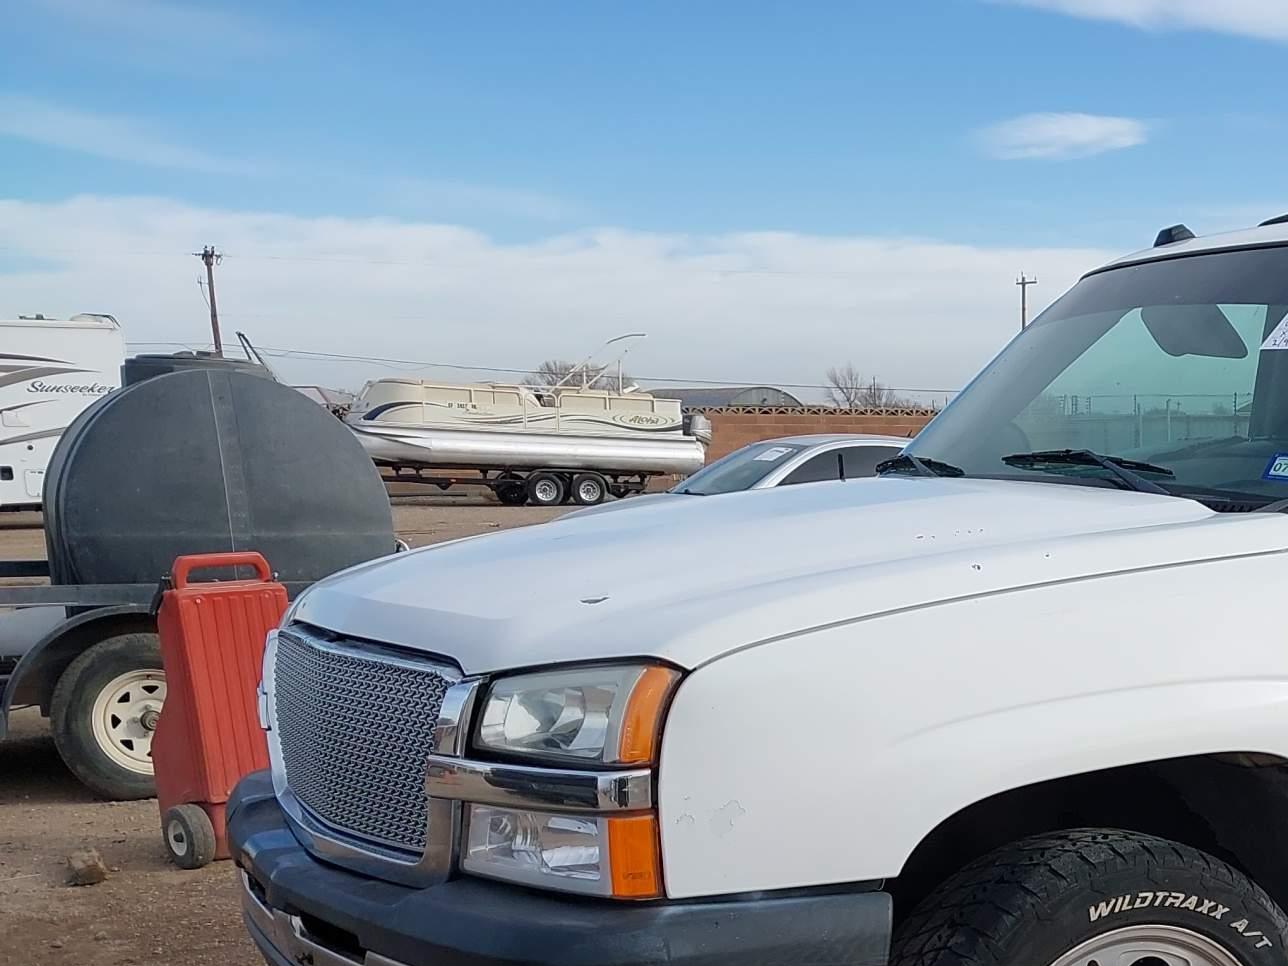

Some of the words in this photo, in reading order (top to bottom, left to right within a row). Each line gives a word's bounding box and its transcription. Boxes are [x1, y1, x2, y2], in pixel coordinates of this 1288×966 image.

[26, 380, 116, 394] Sunseeker
[1088, 891, 1231, 922] WILDTRAXX
[1230, 918, 1273, 949] A/T
